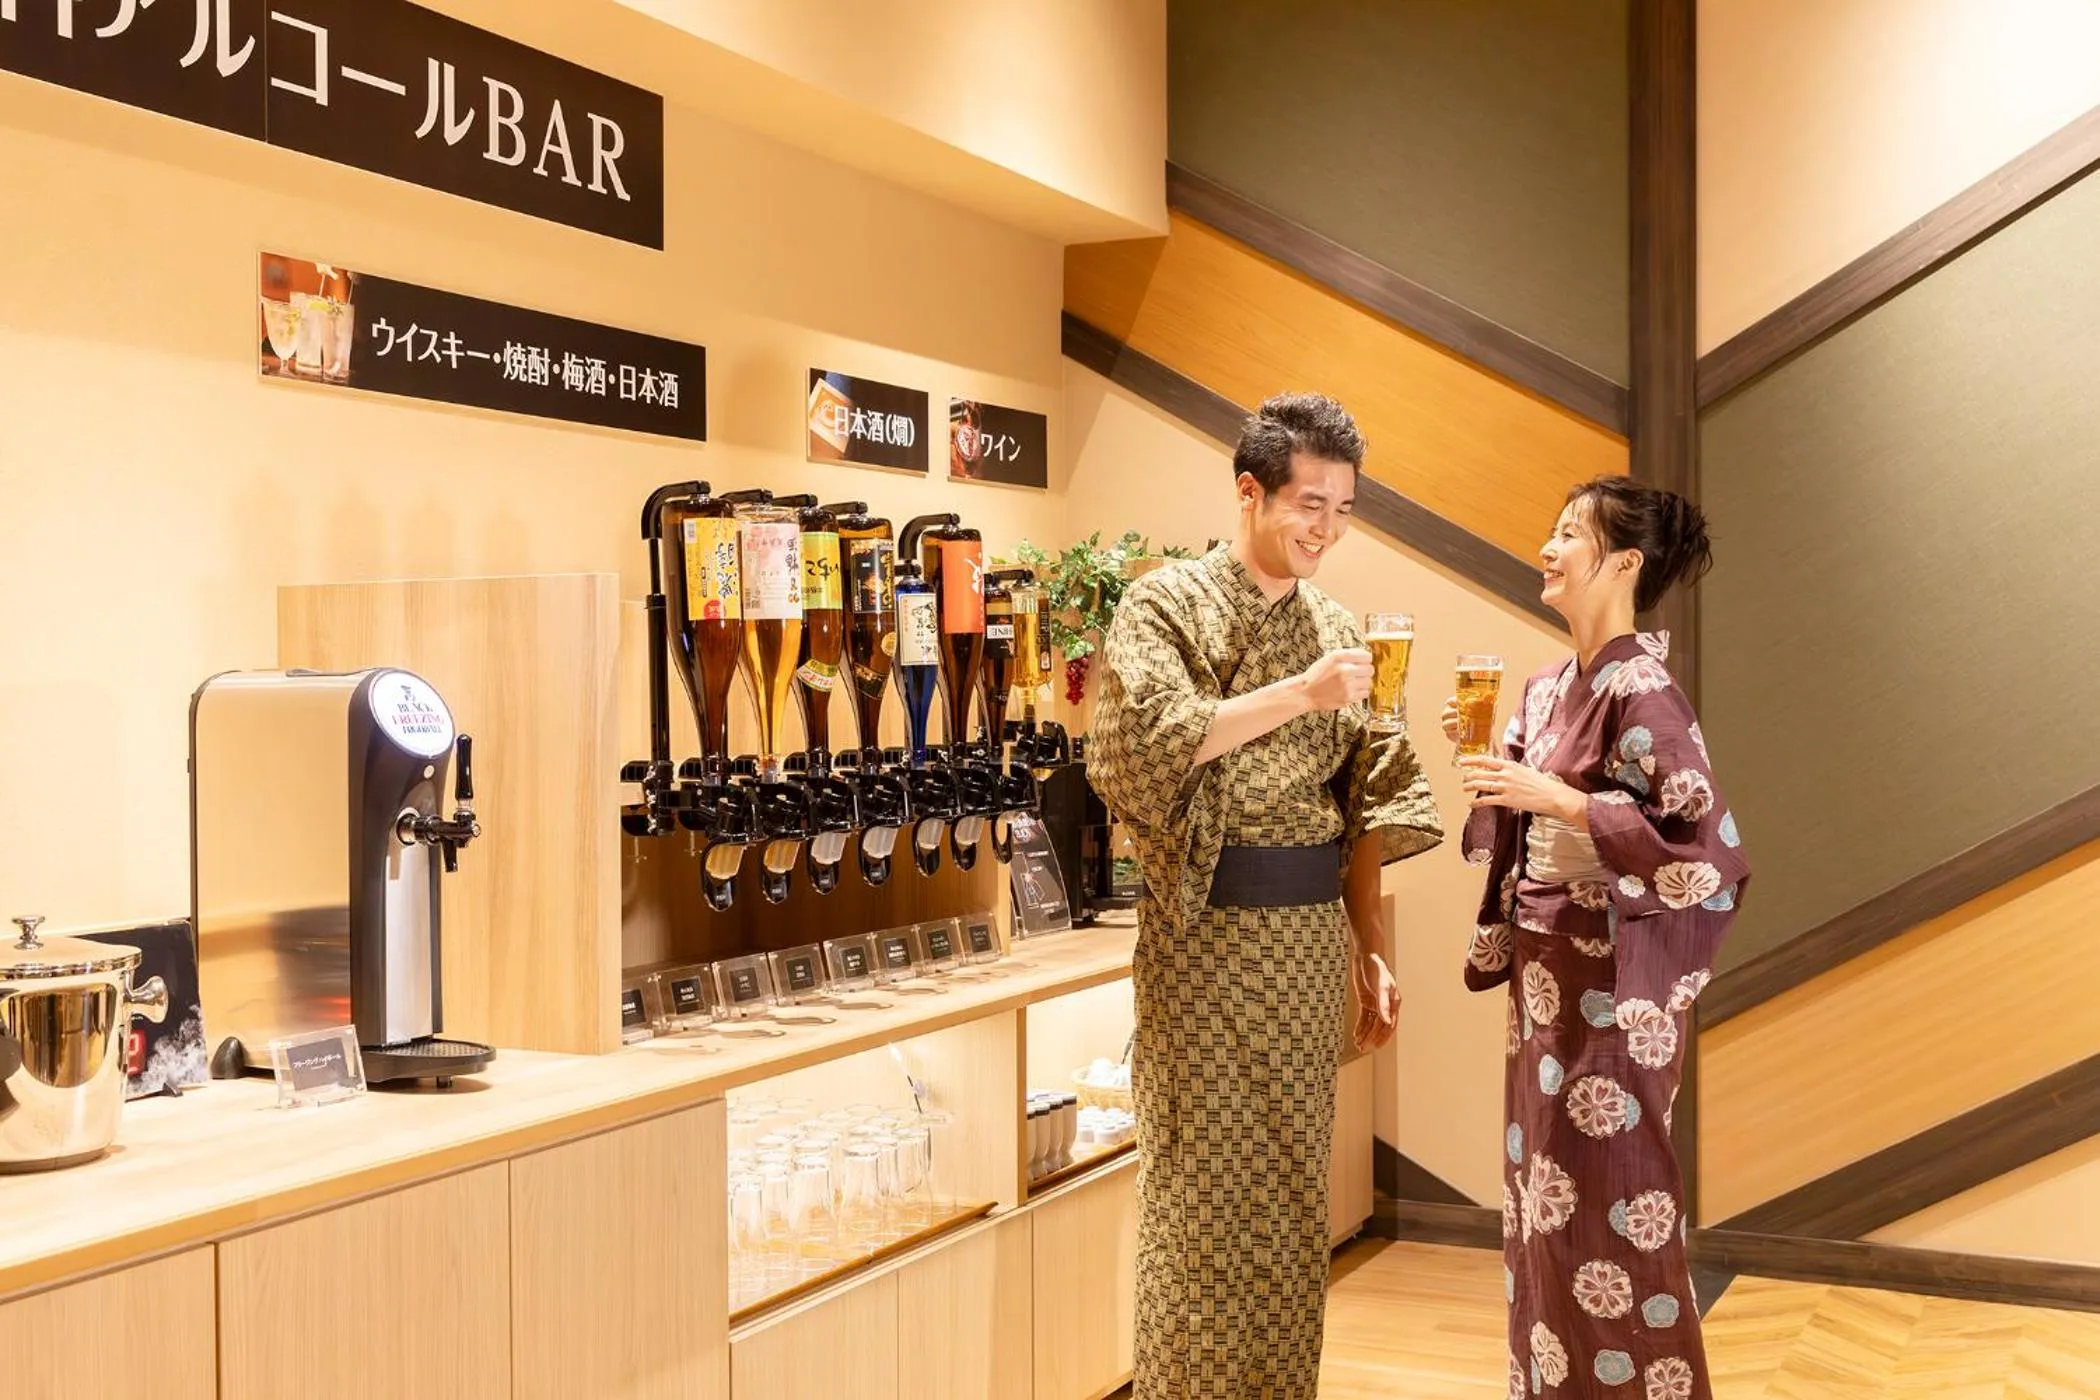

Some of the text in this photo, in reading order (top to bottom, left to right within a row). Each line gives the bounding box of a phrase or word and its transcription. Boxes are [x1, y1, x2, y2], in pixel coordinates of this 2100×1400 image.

[371, 317, 679, 409] ウイスキー・焼酎・梅酒・日本酒
[979, 433, 1022, 462] ワイン
